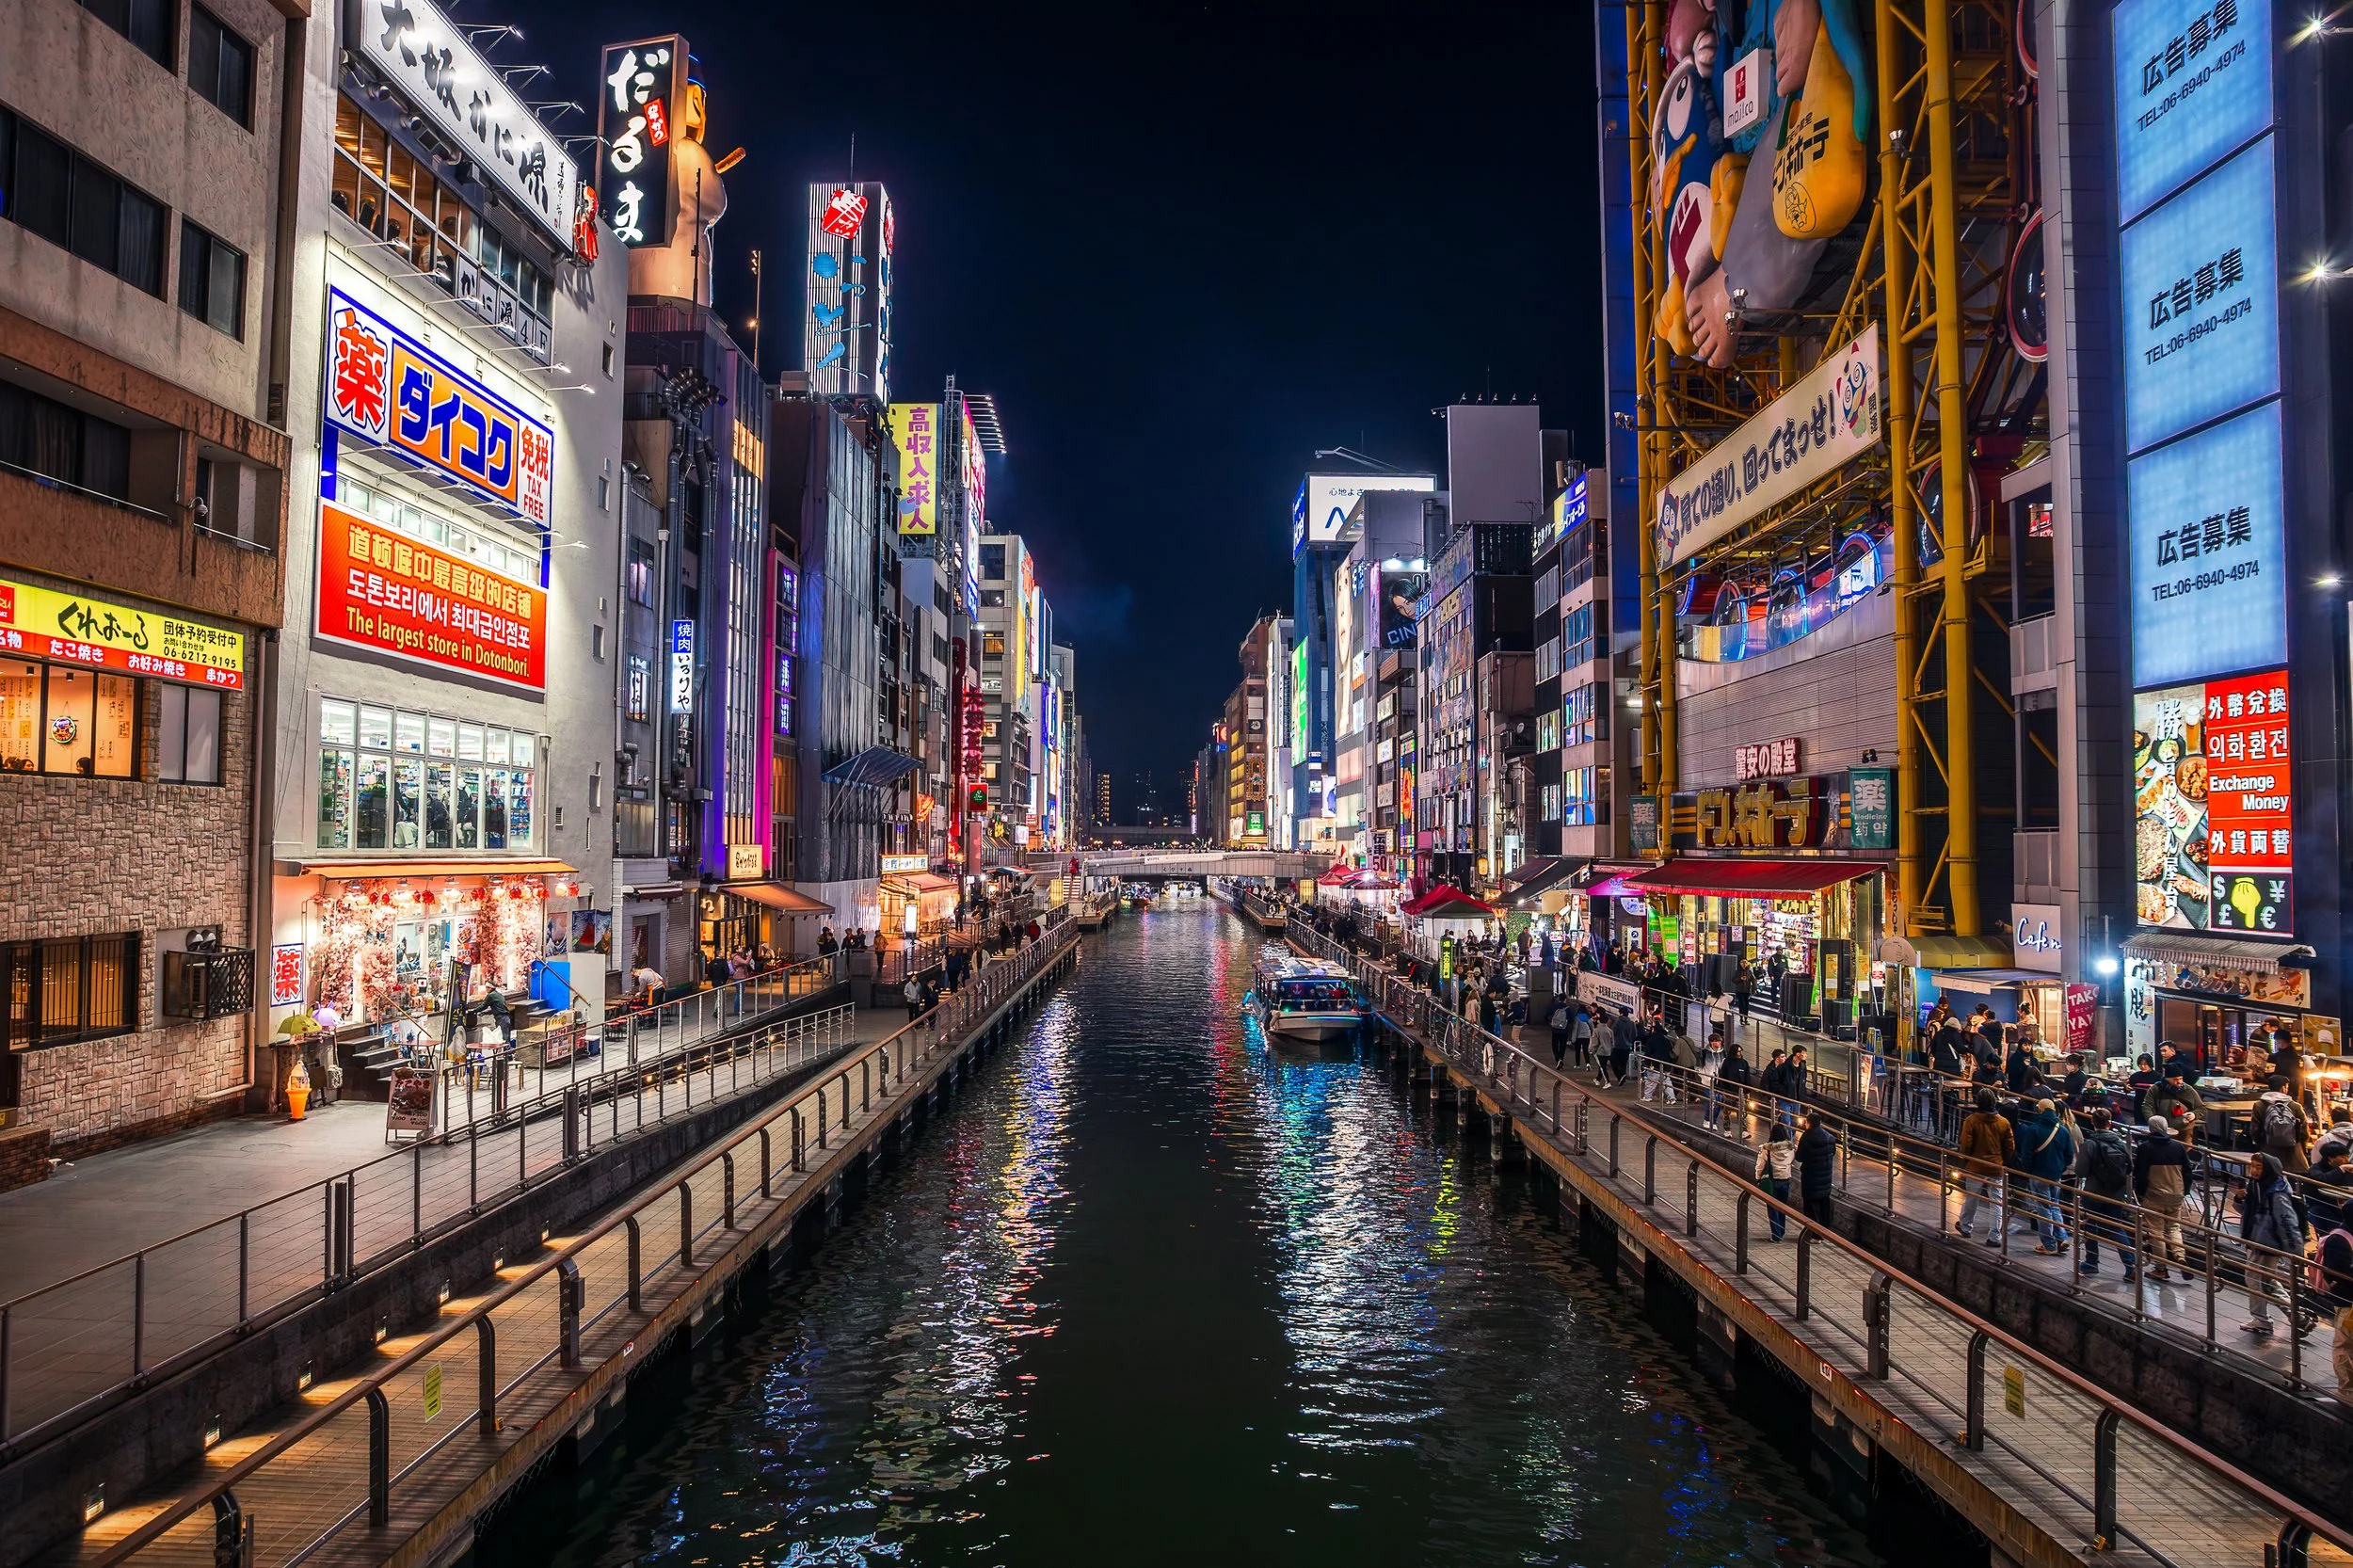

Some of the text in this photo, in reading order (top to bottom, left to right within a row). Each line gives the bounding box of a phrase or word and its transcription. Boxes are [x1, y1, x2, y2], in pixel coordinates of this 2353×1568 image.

[2141, 0, 2239, 96] 広告募集
[2137, 40, 2247, 132] TEL:06-6940-4974
[608, 49, 669, 242] だるま
[2150, 247, 2244, 330] 広告募集
[2145, 297, 2251, 365] TEL:06-6940-4974
[334, 308, 387, 431] 薬
[398, 363, 515, 488] ダイコク
[521, 425, 549, 481] 免税
[905, 407, 932, 530] 高収入求人
[523, 492, 544, 520] FREE
[526, 474, 542, 500] TAX
[2156, 505, 2252, 568] 広告募集
[346, 570, 448, 628] 도톤보리에서
[2152, 560, 2260, 601] TEL:06-6940-4974
[164, 621, 237, 648] 団体予約受付中
[346, 606, 530, 677] The largest store in Dotonbori.
[677, 623, 692, 652] 焼肉
[50, 639, 104, 663] たこ焼き
[128, 654, 186, 677] お好み焼き
[206, 668, 236, 685] 串かつ
[164, 647, 236, 669] 06-6212-9195
[2155, 699, 2182, 742] 勝
[1736, 739, 1798, 780] 驚安の殿堂
[2209, 727, 2288, 763] 외화환전
[1854, 779, 1886, 810] 薬
[2209, 775, 2275, 792] Exchange
[2242, 794, 2289, 812] Money
[1633, 803, 1654, 824] 薬
[2211, 829, 2290, 856] 外貨両替
[1372, 856, 1386, 872] 50
[2213, 875, 2226, 900] $
[2269, 880, 2285, 903] ¥
[2219, 904, 2233, 925] £
[2261, 906, 2276, 929] €
[274, 948, 300, 1000] 薬
